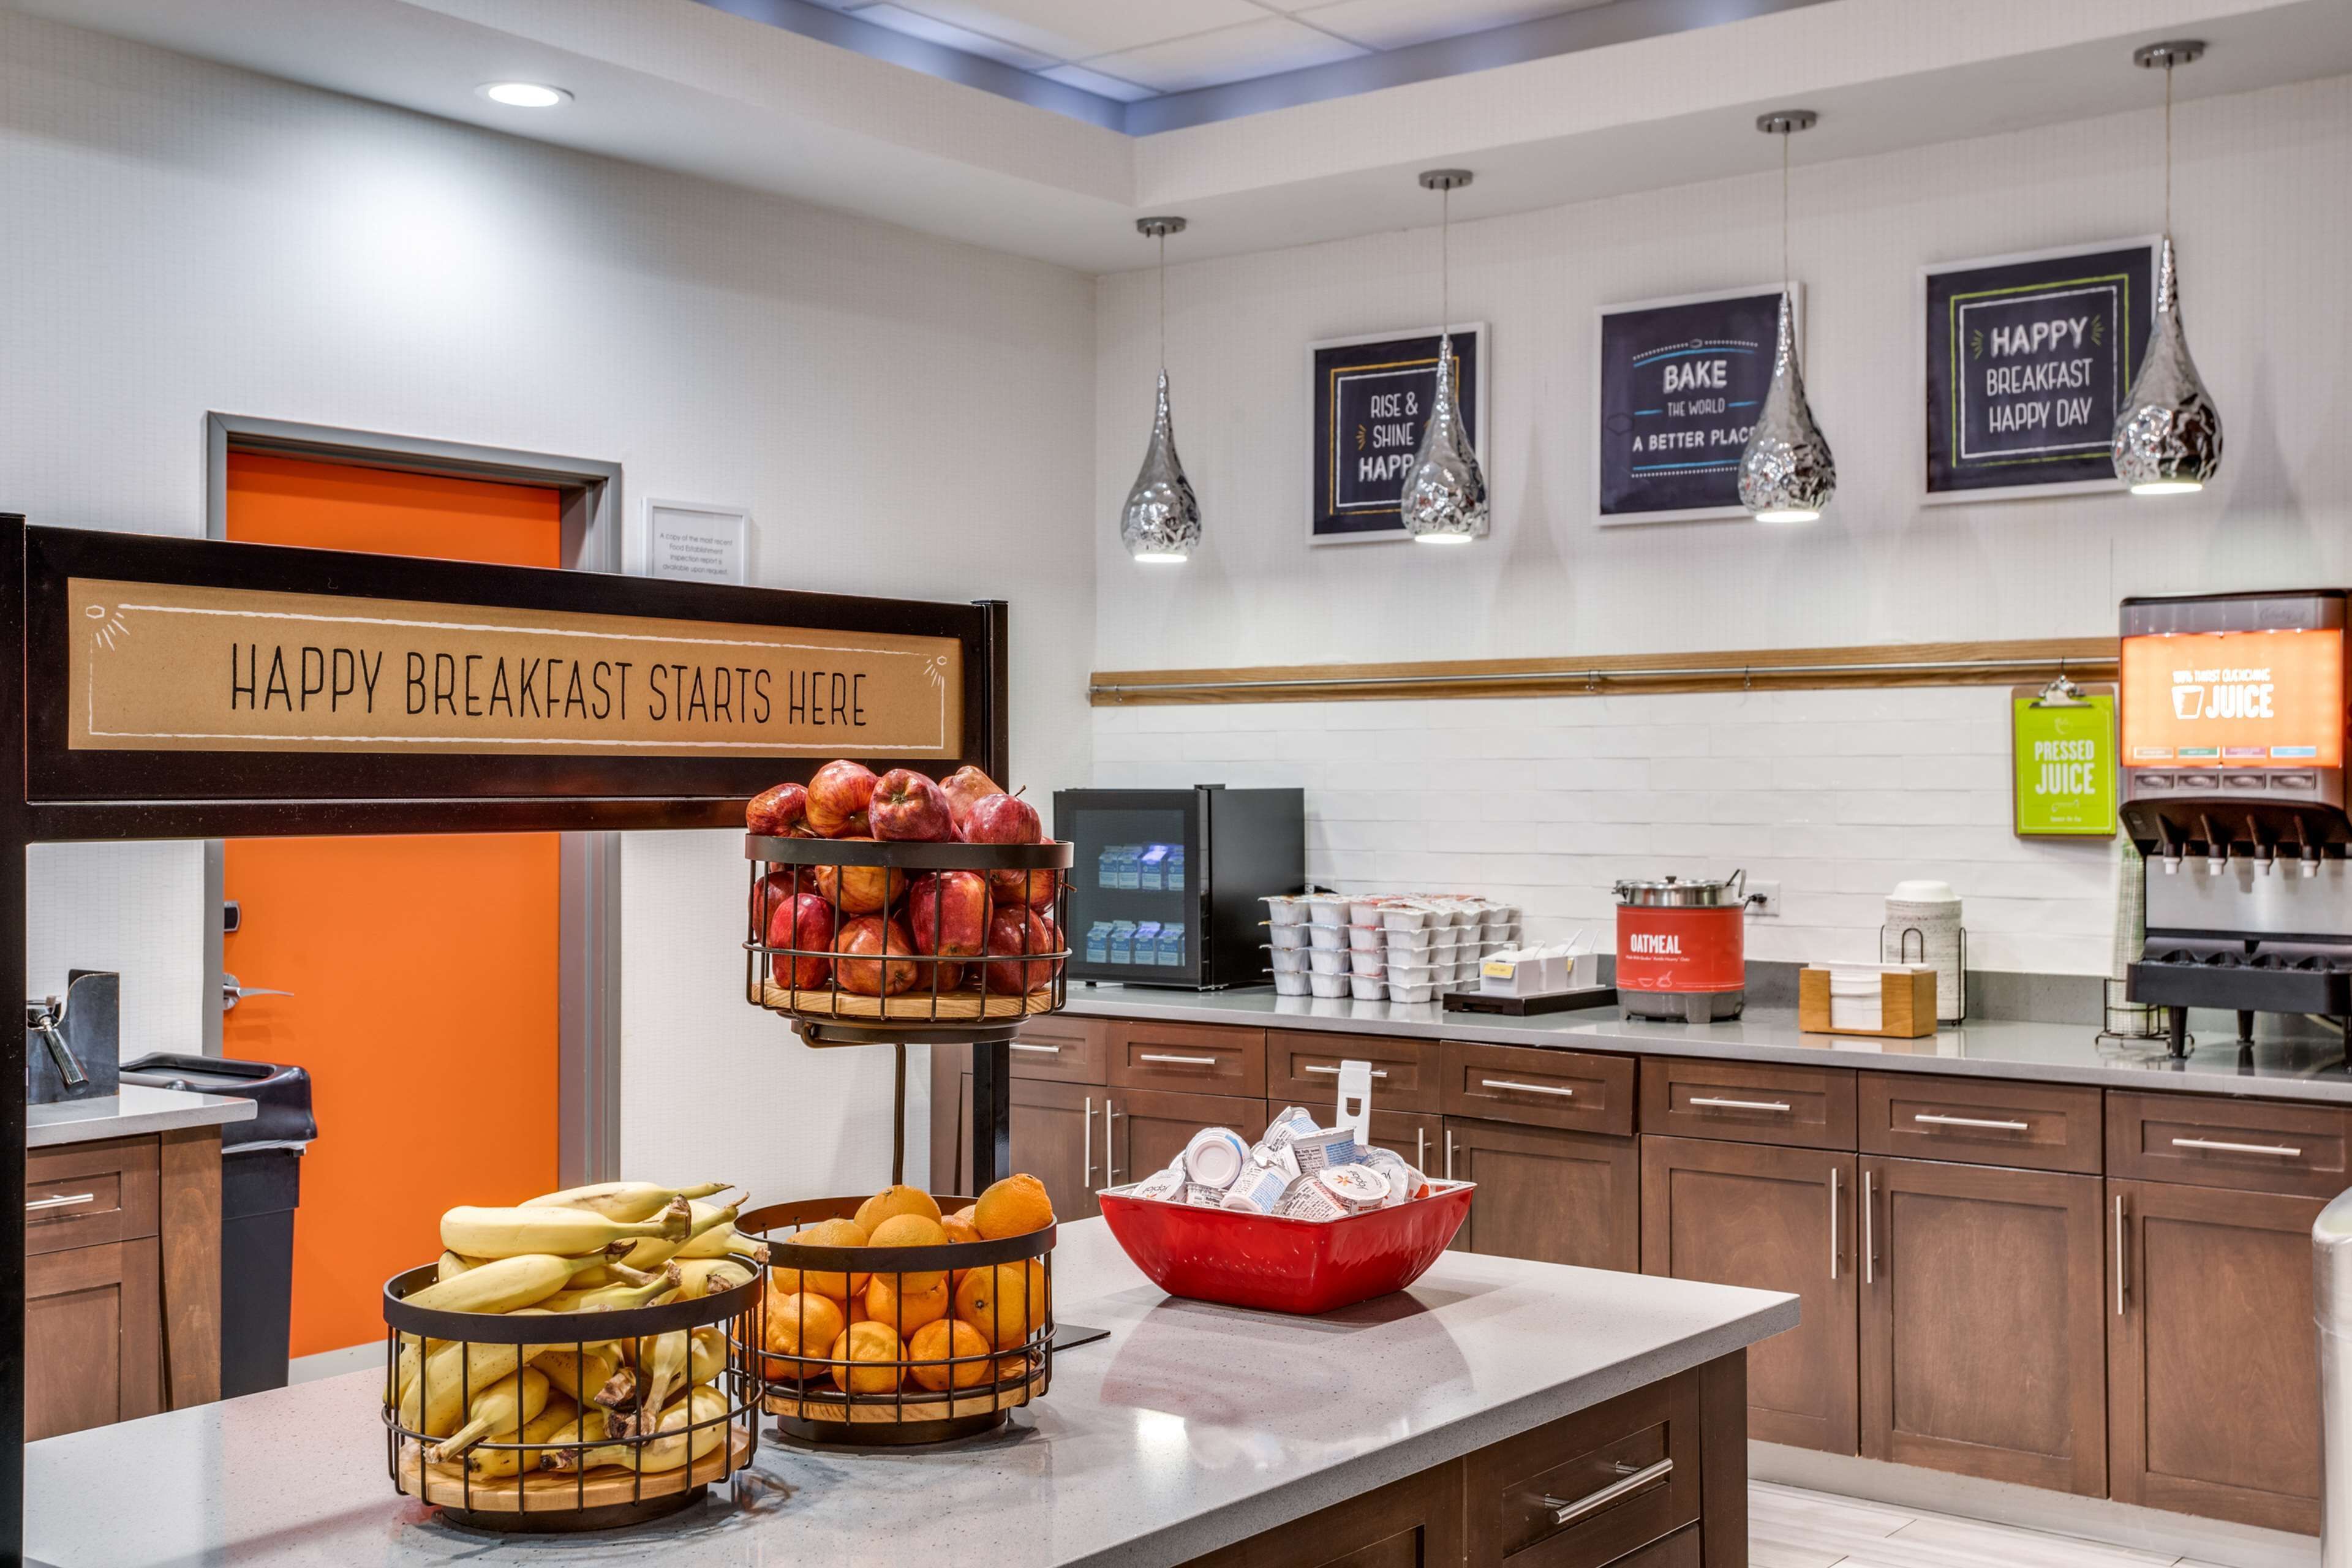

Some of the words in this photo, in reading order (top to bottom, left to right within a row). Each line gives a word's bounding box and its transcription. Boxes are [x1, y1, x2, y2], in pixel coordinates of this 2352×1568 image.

[1991, 317, 2088, 356] HAPPY
[1662, 360, 1727, 394] BAKE
[1986, 358, 2093, 396] BREAKFAST
[1371, 393, 1401, 418] RISE
[1406, 391, 1418, 415] &
[1668, 401, 1685, 417] THE
[1688, 398, 1725, 415] WORLD
[1989, 401, 2051, 434] HAPPY
[2056, 397, 2092, 428] DAY
[1373, 422, 1414, 448] SHINE
[1632, 436, 1643, 452] A
[1648, 431, 1705, 451] BETTER
[1359, 453, 1414, 483] HAPP
[669, 543, 684, 551] Food
[685, 545, 723, 554] Establishment
[663, 564, 689, 572] available
[232, 643, 382, 713] HAPPY
[407, 652, 633, 720] BREAKFAST
[649, 663, 771, 724] STARTS
[789, 670, 867, 726] HERE
[2205, 684, 2274, 719] JUICE
[2034, 739, 2095, 761] PRESSED
[2035, 763, 2096, 794] JUICE
[1630, 933, 1682, 954] OATMEAL
